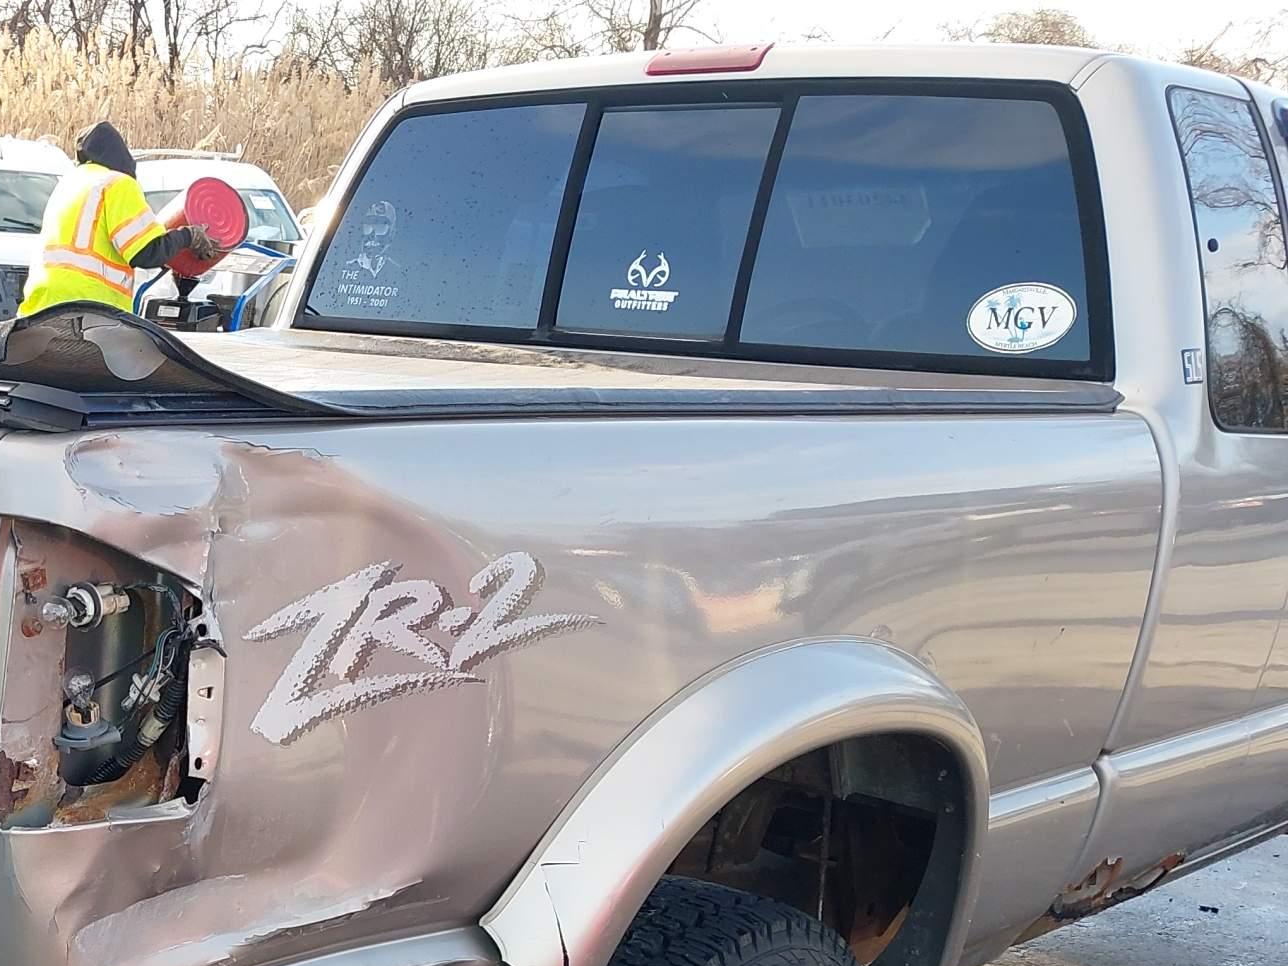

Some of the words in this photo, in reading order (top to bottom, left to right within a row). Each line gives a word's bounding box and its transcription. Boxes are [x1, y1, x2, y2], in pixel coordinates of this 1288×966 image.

[342, 269, 360, 280] THE
[337, 283, 399, 297] INTIMIDATOR
[347, 296, 362, 305] 1951
[370, 298, 388, 307] 2001
[614, 299, 669, 312] OUTFITTERS
[985, 305, 1058, 330] MGV
[242, 552, 605, 746] ZR2
